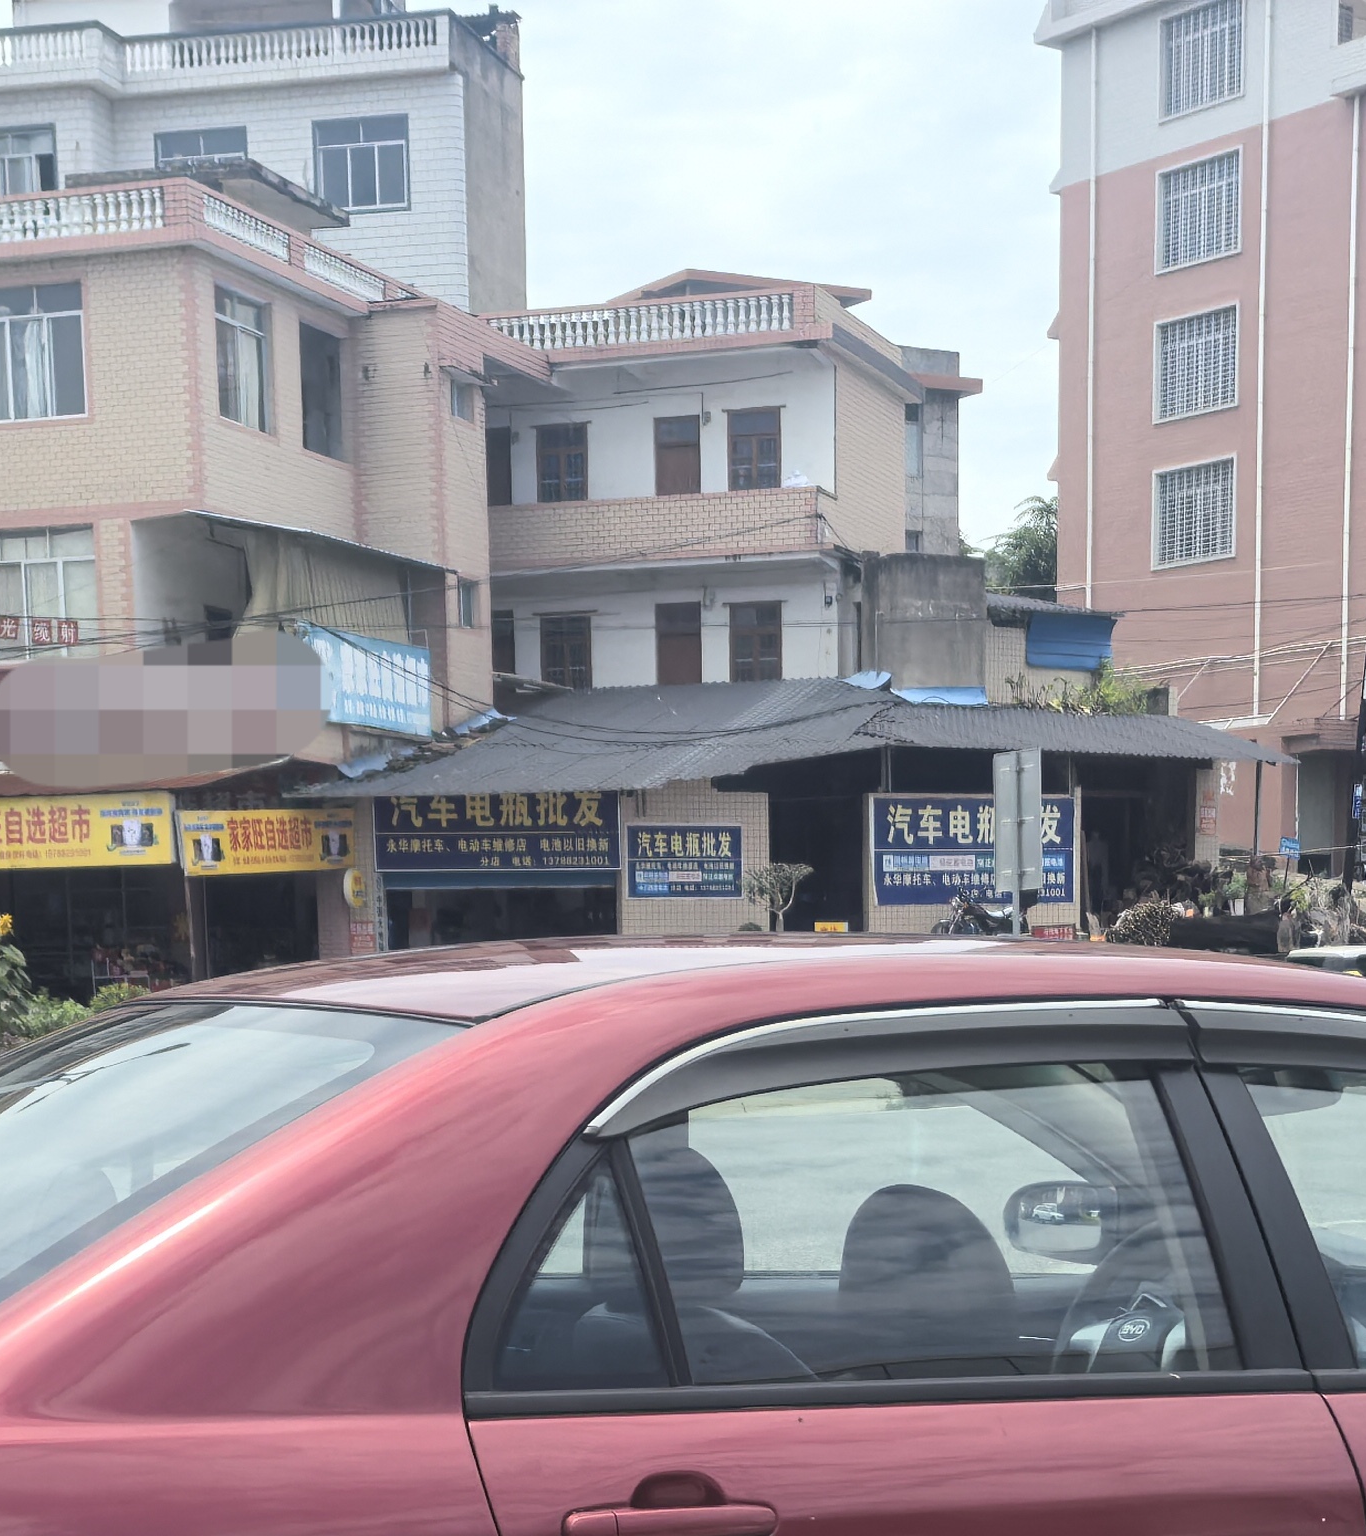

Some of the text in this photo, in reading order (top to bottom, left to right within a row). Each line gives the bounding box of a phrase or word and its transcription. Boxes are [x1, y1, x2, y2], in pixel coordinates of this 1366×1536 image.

[391, 792, 603, 828] 汽车电瓶批发
[886, 804, 1062, 845] 汽车电瓶发
[227, 815, 312, 852] 家家旺自选超市
[540, 837, 610, 853] 电池以旧换新
[637, 831, 732, 857] 汽车电瓶批发
[1122, 1324, 1145, 1335] BYD
